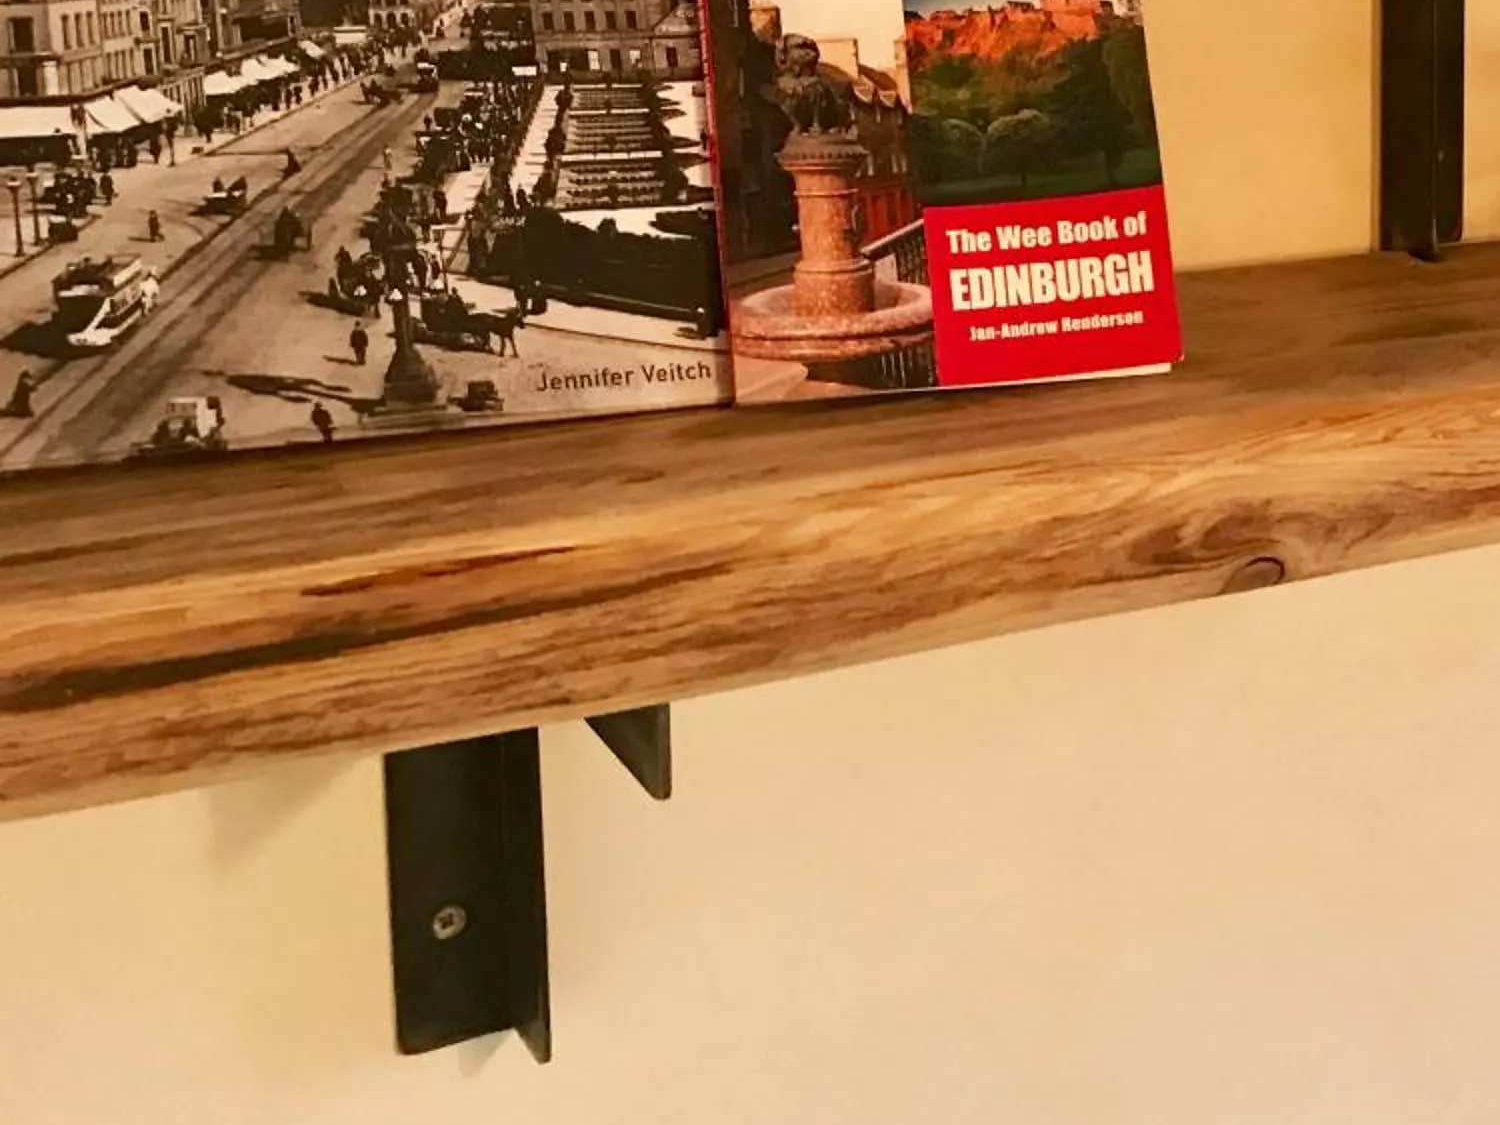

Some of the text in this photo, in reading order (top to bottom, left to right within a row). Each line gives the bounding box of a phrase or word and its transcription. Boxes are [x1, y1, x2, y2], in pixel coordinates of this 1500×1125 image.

[946, 210, 1147, 254] The Wee Book of
[949, 250, 1155, 311] EDINBURGH
[1061, 311, 1144, 332] Henderson
[536, 361, 711, 392] Jennifer Veitch
